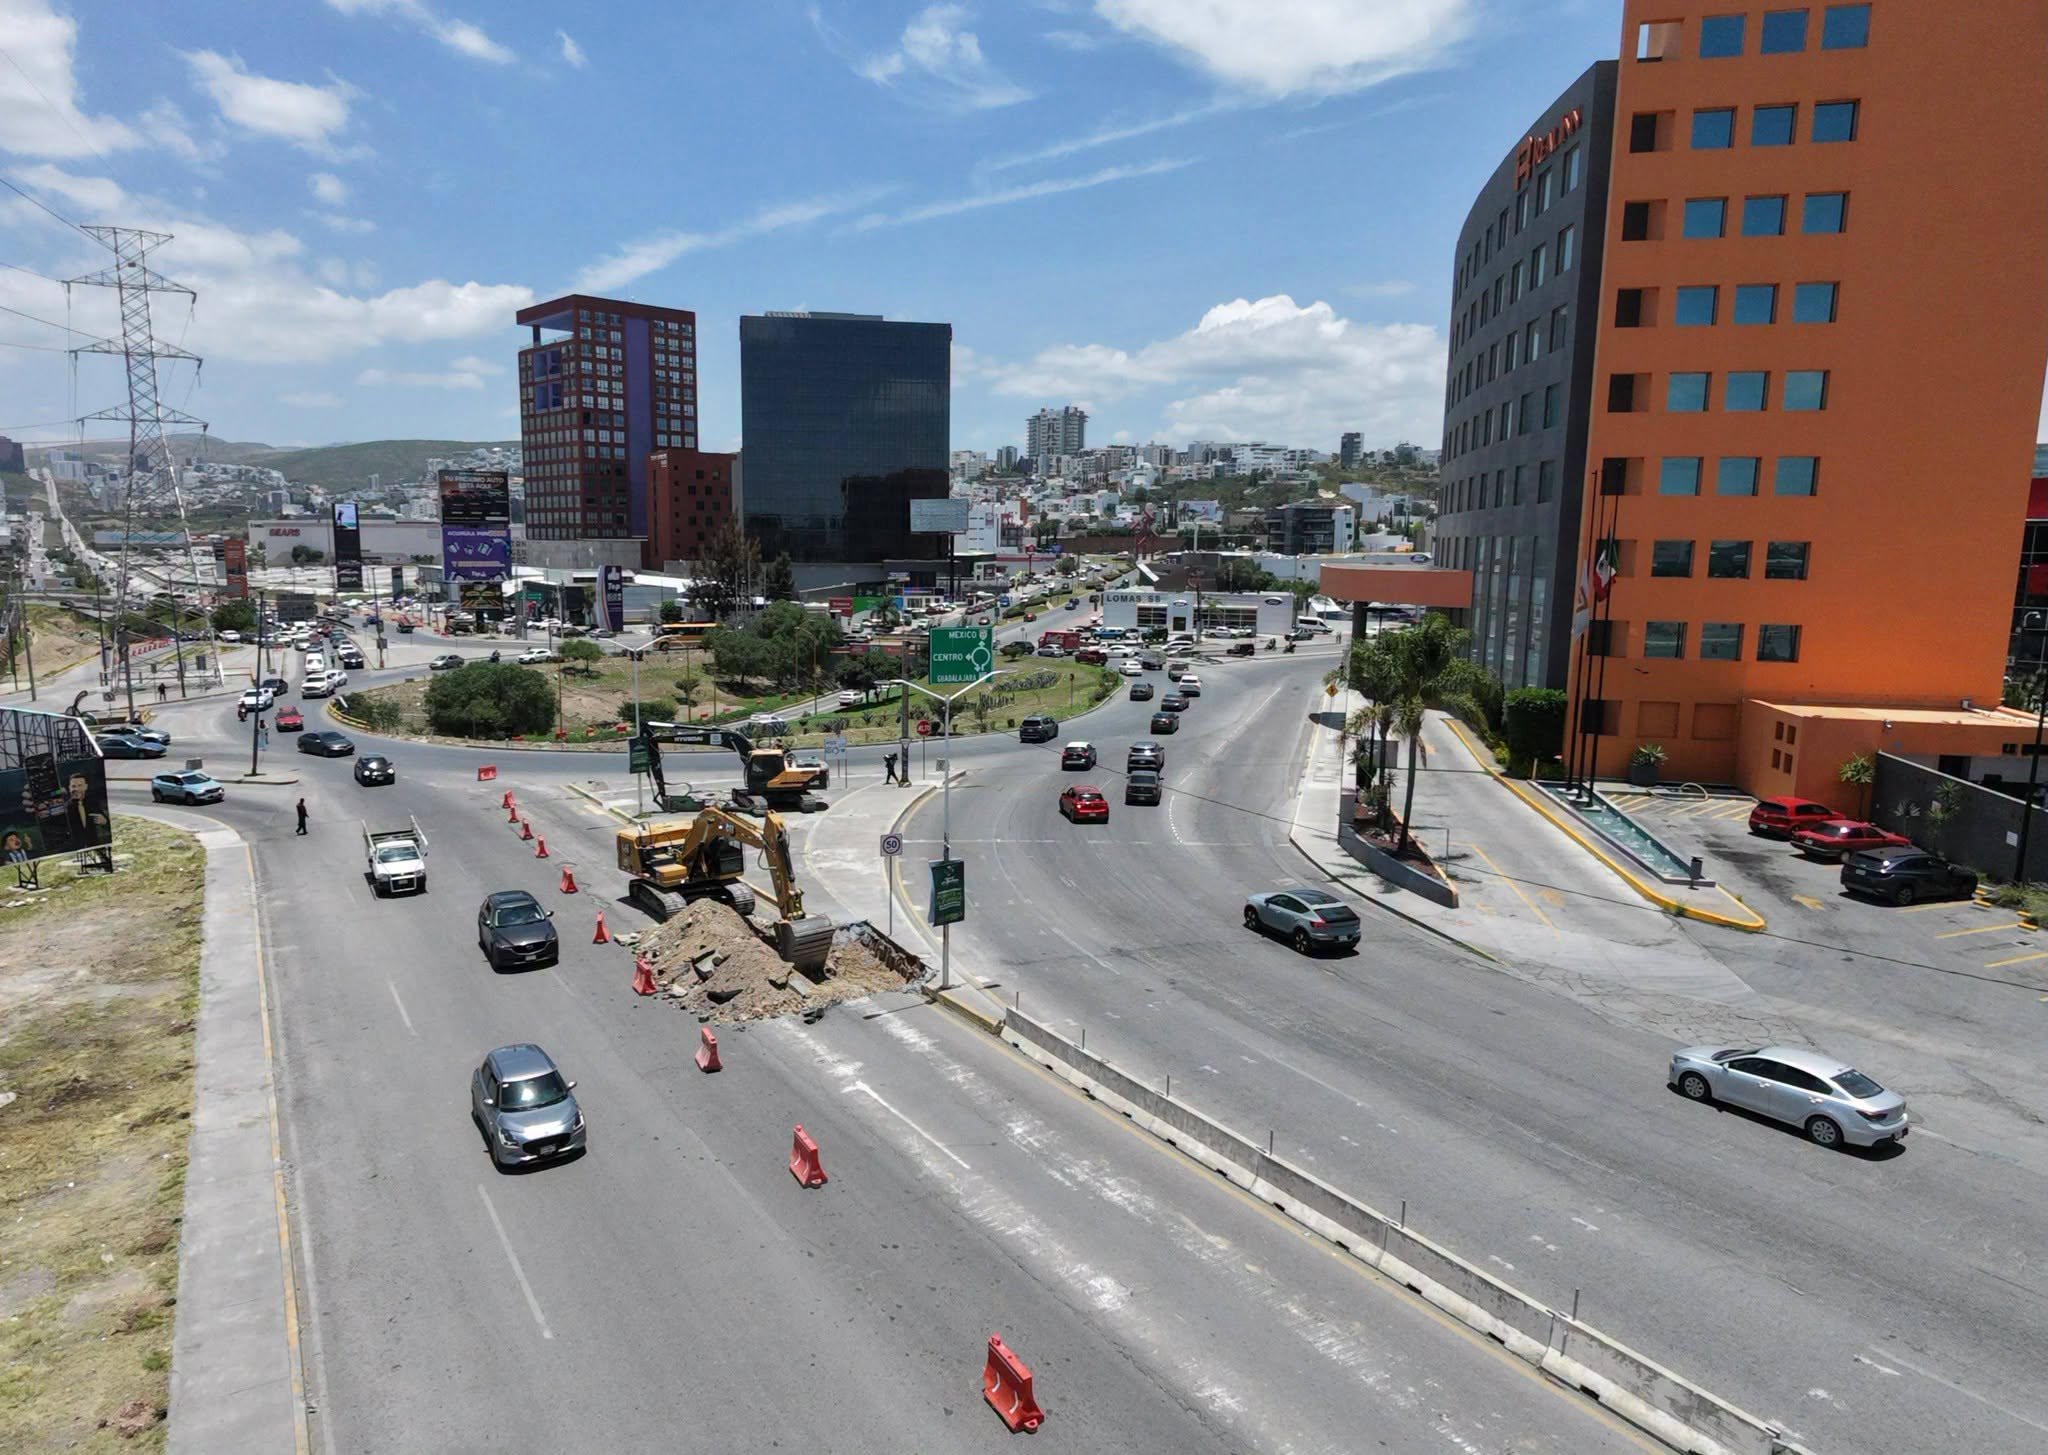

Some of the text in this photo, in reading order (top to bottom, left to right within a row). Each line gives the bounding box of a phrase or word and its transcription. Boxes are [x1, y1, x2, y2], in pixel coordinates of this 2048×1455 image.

[269, 528, 301, 537] SEARS
[1106, 594, 1141, 602] LOMAS
[933, 653, 963, 662] CENTRO
[937, 674, 977, 683] GUADALAJARA
[886, 840, 898, 850] 50
